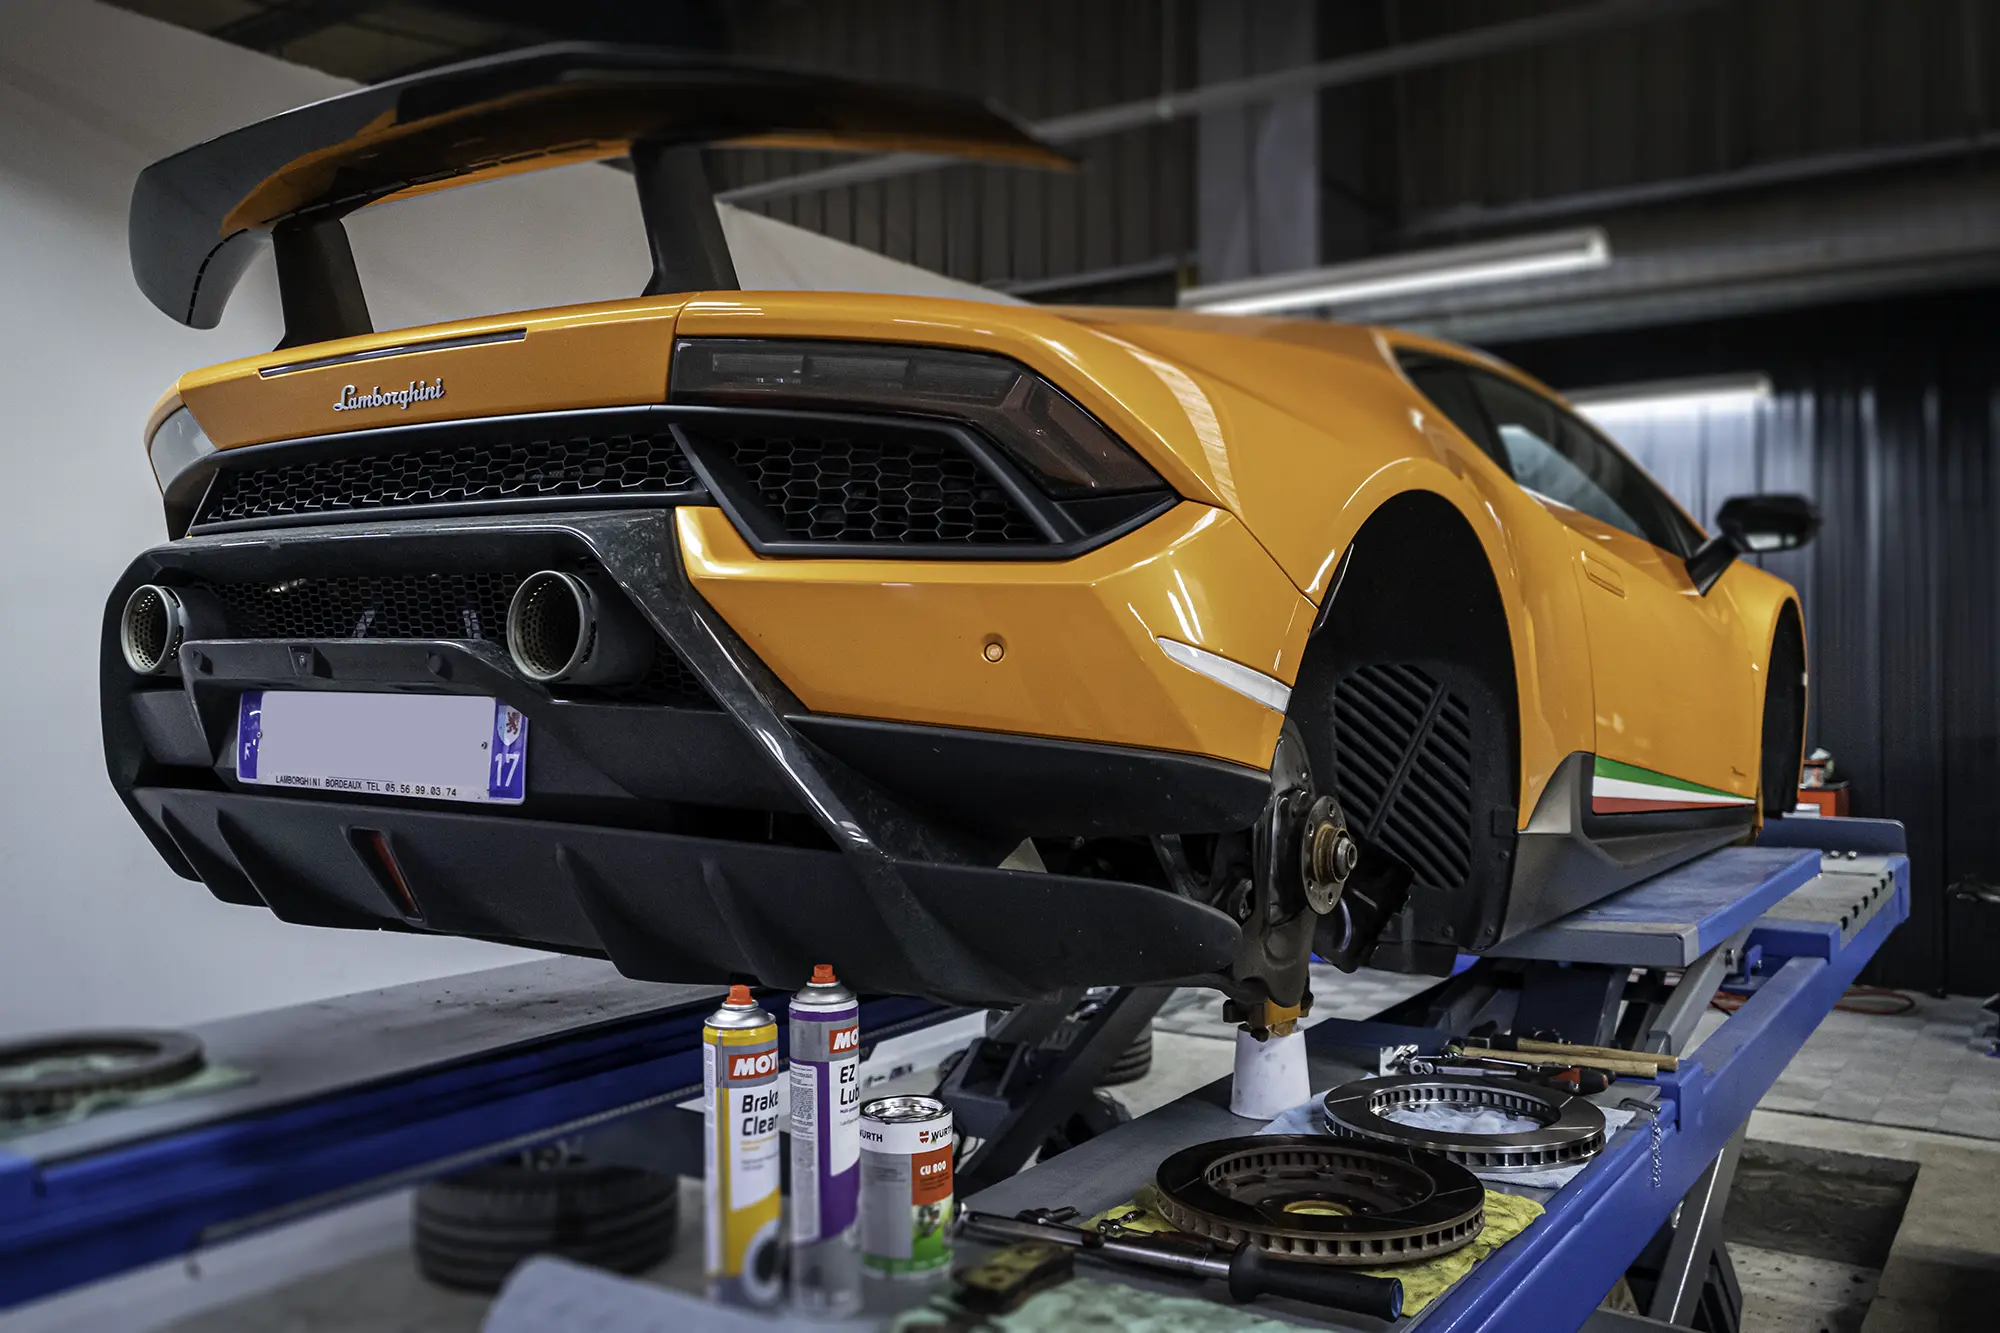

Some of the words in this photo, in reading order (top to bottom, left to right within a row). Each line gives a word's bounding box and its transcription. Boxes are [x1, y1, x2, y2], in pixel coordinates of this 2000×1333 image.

[333, 377, 445, 411] Lamborghini
[495, 753, 519, 787] 17
[275, 775, 321, 787] LAMBORGHINI
[325, 778, 362, 789] BORDEAUX
[366, 781, 381, 791] TEL
[385, 783, 457, 796] 05.56.99.03.74
[733, 1051, 778, 1077] MOT
[840, 1064, 855, 1084] EZ
[742, 1090, 778, 1113] Brake
[920, 1164, 931, 1176] CU
[933, 1160, 947, 1173] 800
